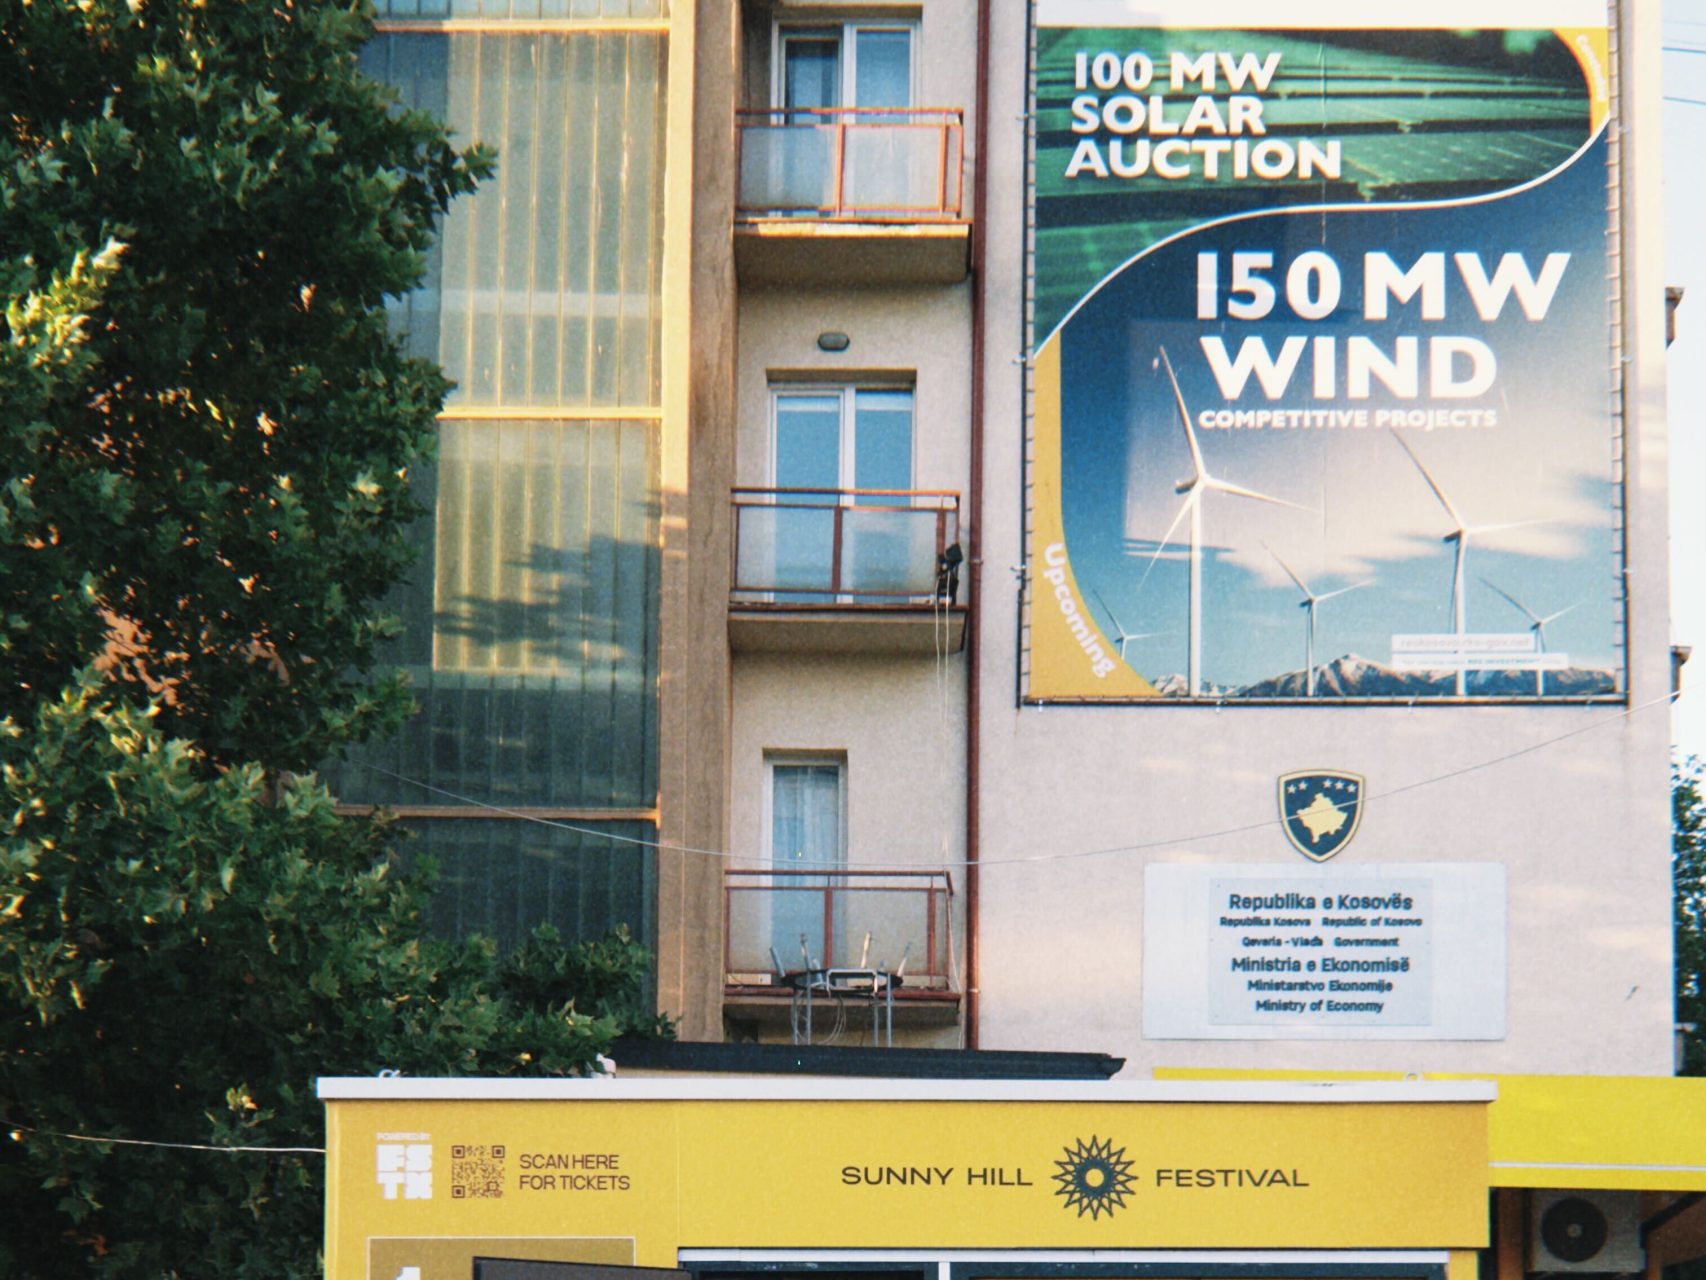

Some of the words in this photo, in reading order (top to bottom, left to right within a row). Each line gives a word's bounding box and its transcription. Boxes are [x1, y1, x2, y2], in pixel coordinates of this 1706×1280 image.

[1075, 52, 1153, 91] 100
[1169, 52, 1282, 92] MW
[1071, 95, 1266, 136] SOLAR
[1064, 139, 1341, 179] AUCTION
[1197, 250, 1342, 321] 150
[1364, 252, 1572, 321] MW
[1200, 335, 1498, 400] WIND
[1198, 409, 1368, 429] COMPETITIVE
[1375, 409, 1498, 431] PROJECTS
[1043, 543, 1116, 678] Upcoming
[1229, 893, 1316, 911] Republika
[1322, 898, 1333, 910] e
[1337, 893, 1413, 910] Kosovës
[1220, 917, 1270, 927] Republika
[1273, 917, 1311, 926] Kosova
[1322, 917, 1367, 927] Republic
[1370, 917, 1382, 926] of
[1384, 917, 1423, 926] Kosovo
[1334, 937, 1399, 946] Government
[1231, 957, 1302, 972] Ministria
[1306, 961, 1316, 972] e
[1321, 957, 1410, 972] Ekonomisë
[1248, 980, 1325, 991] Ministarstvo
[1329, 980, 1393, 993] Ekonomije
[1256, 1000, 1306, 1012] Ministry
[1310, 1000, 1323, 1011] of
[1326, 1000, 1384, 1013] Economy
[519, 1154, 569, 1170] SCAN
[572, 1154, 620, 1170] HERE
[519, 1175, 556, 1191] FOR
[559, 1174, 631, 1191] TICKETS
[841, 1166, 954, 1186] SUNNY
[967, 1167, 1033, 1186] HILL
[1157, 1168, 1310, 1188] FESTIVAL
